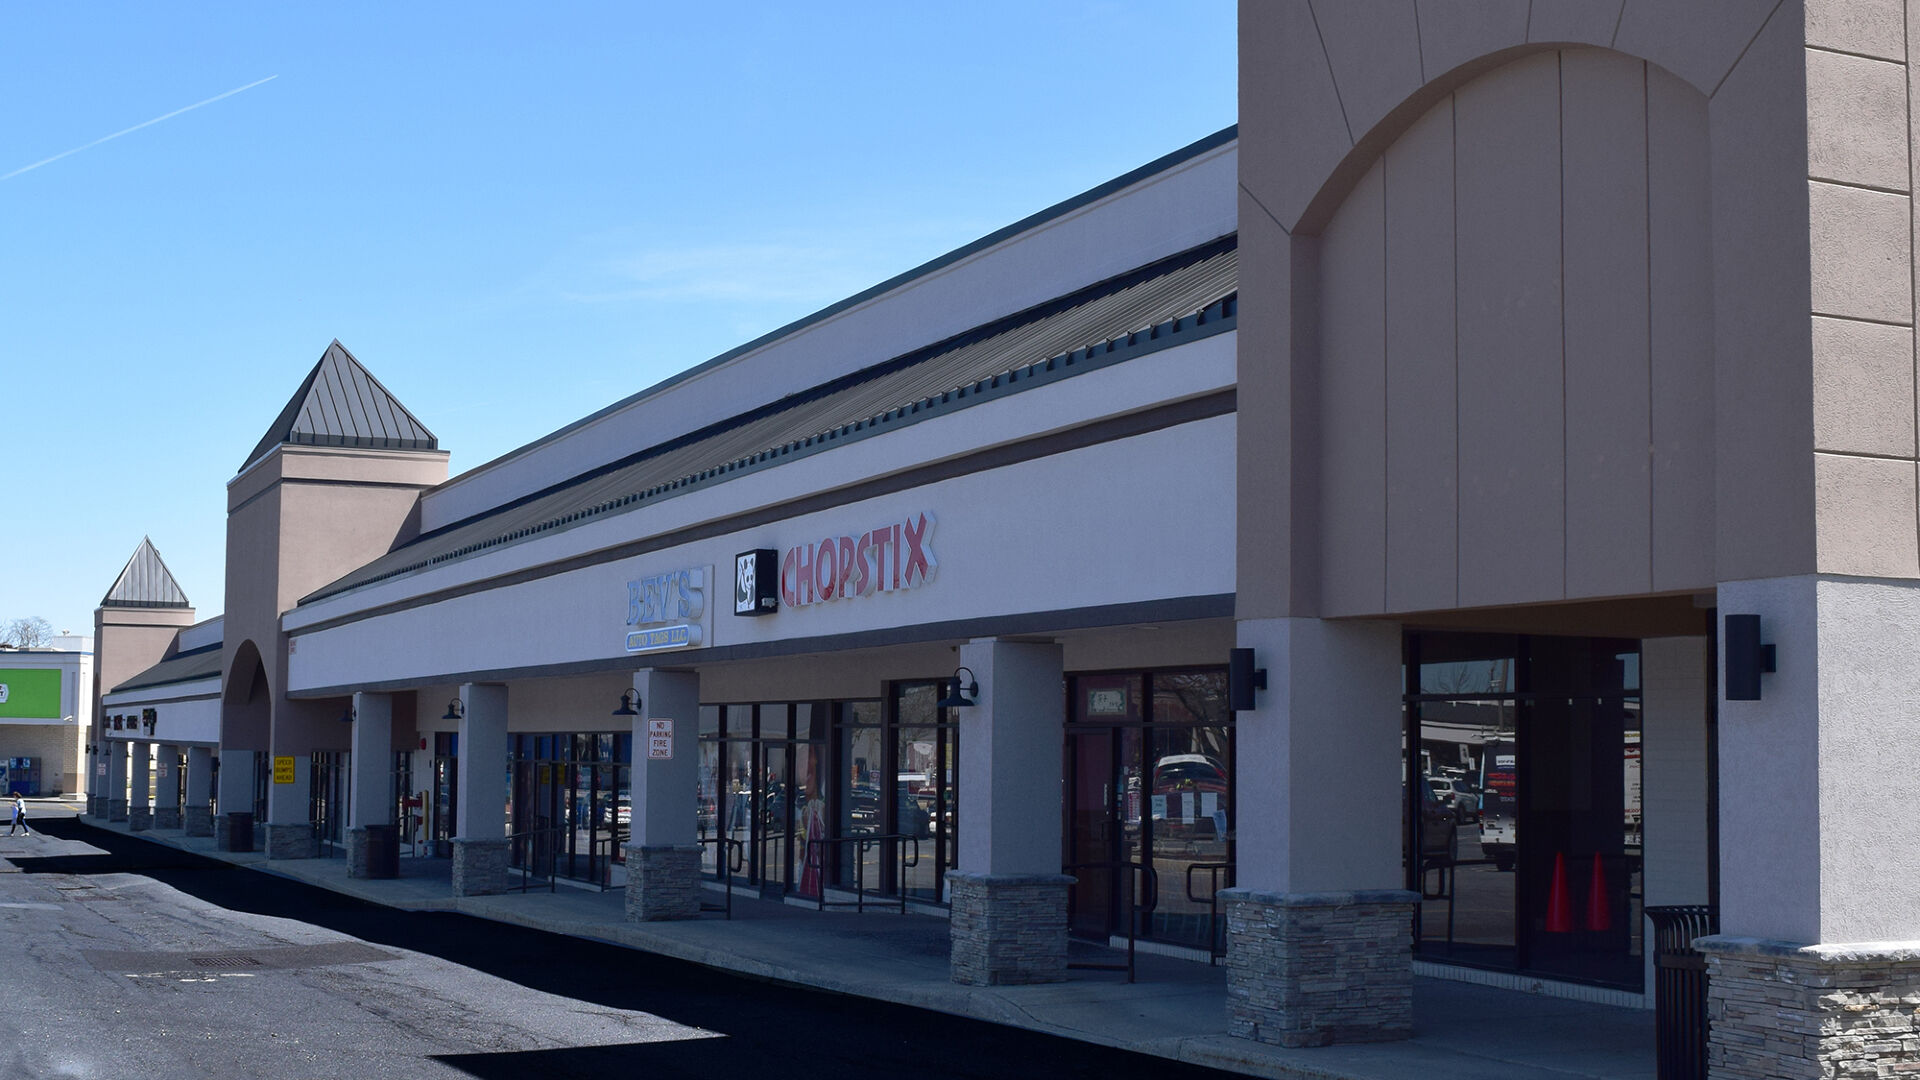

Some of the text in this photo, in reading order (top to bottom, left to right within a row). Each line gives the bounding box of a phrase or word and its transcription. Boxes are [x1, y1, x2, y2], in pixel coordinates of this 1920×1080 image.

[781, 512, 936, 608] CHOPSTIX
[627, 571, 699, 625] BEV'S
[628, 634, 647, 648] AUTO
[650, 631, 669, 645] TAGS
